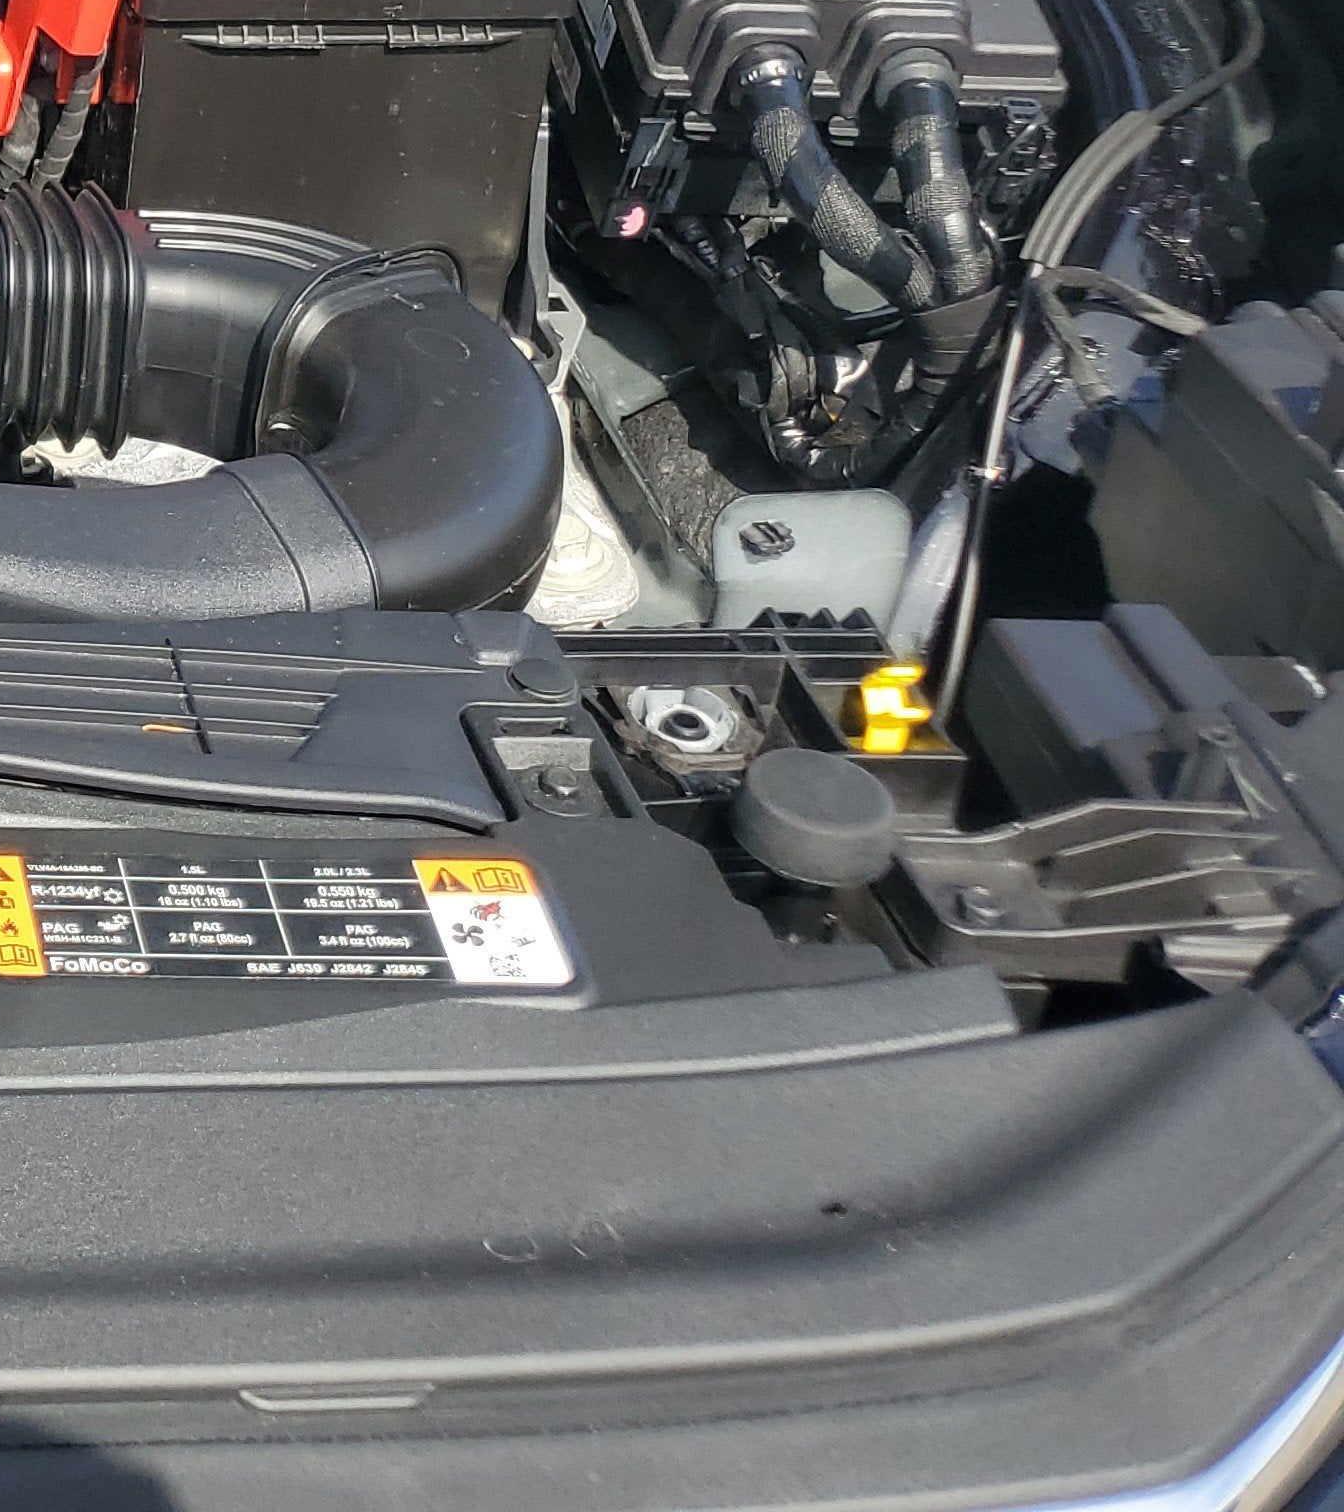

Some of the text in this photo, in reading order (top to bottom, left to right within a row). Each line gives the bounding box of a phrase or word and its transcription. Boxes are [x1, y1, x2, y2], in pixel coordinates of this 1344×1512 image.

[30, 884, 101, 900] R-1234yf
[167, 884, 227, 898] 0.500 kg
[317, 885, 378, 899] 0.550 kg
[174, 898, 189, 906] oz
[190, 896, 218, 908] (1.10
[220, 897, 244, 909] lbs)
[303, 898, 401, 910] 19.5 oz (1.21 lbs)
[41, 921, 82, 934] PAG
[192, 921, 224, 932] PAG
[345, 924, 379, 935] PAG
[168, 932, 188, 943] 2.7
[199, 935, 215, 943] oz
[216, 933, 254, 946] (80cc)
[318, 935, 339, 947] 3.4
[350, 938, 366, 947] oz
[366, 936, 411, 949] (100cc)
[49, 956, 150, 974] FoMoCo
[246, 962, 284, 974] SAE
[330, 963, 377, 976] J2842
[382, 963, 430, 977] J2845
